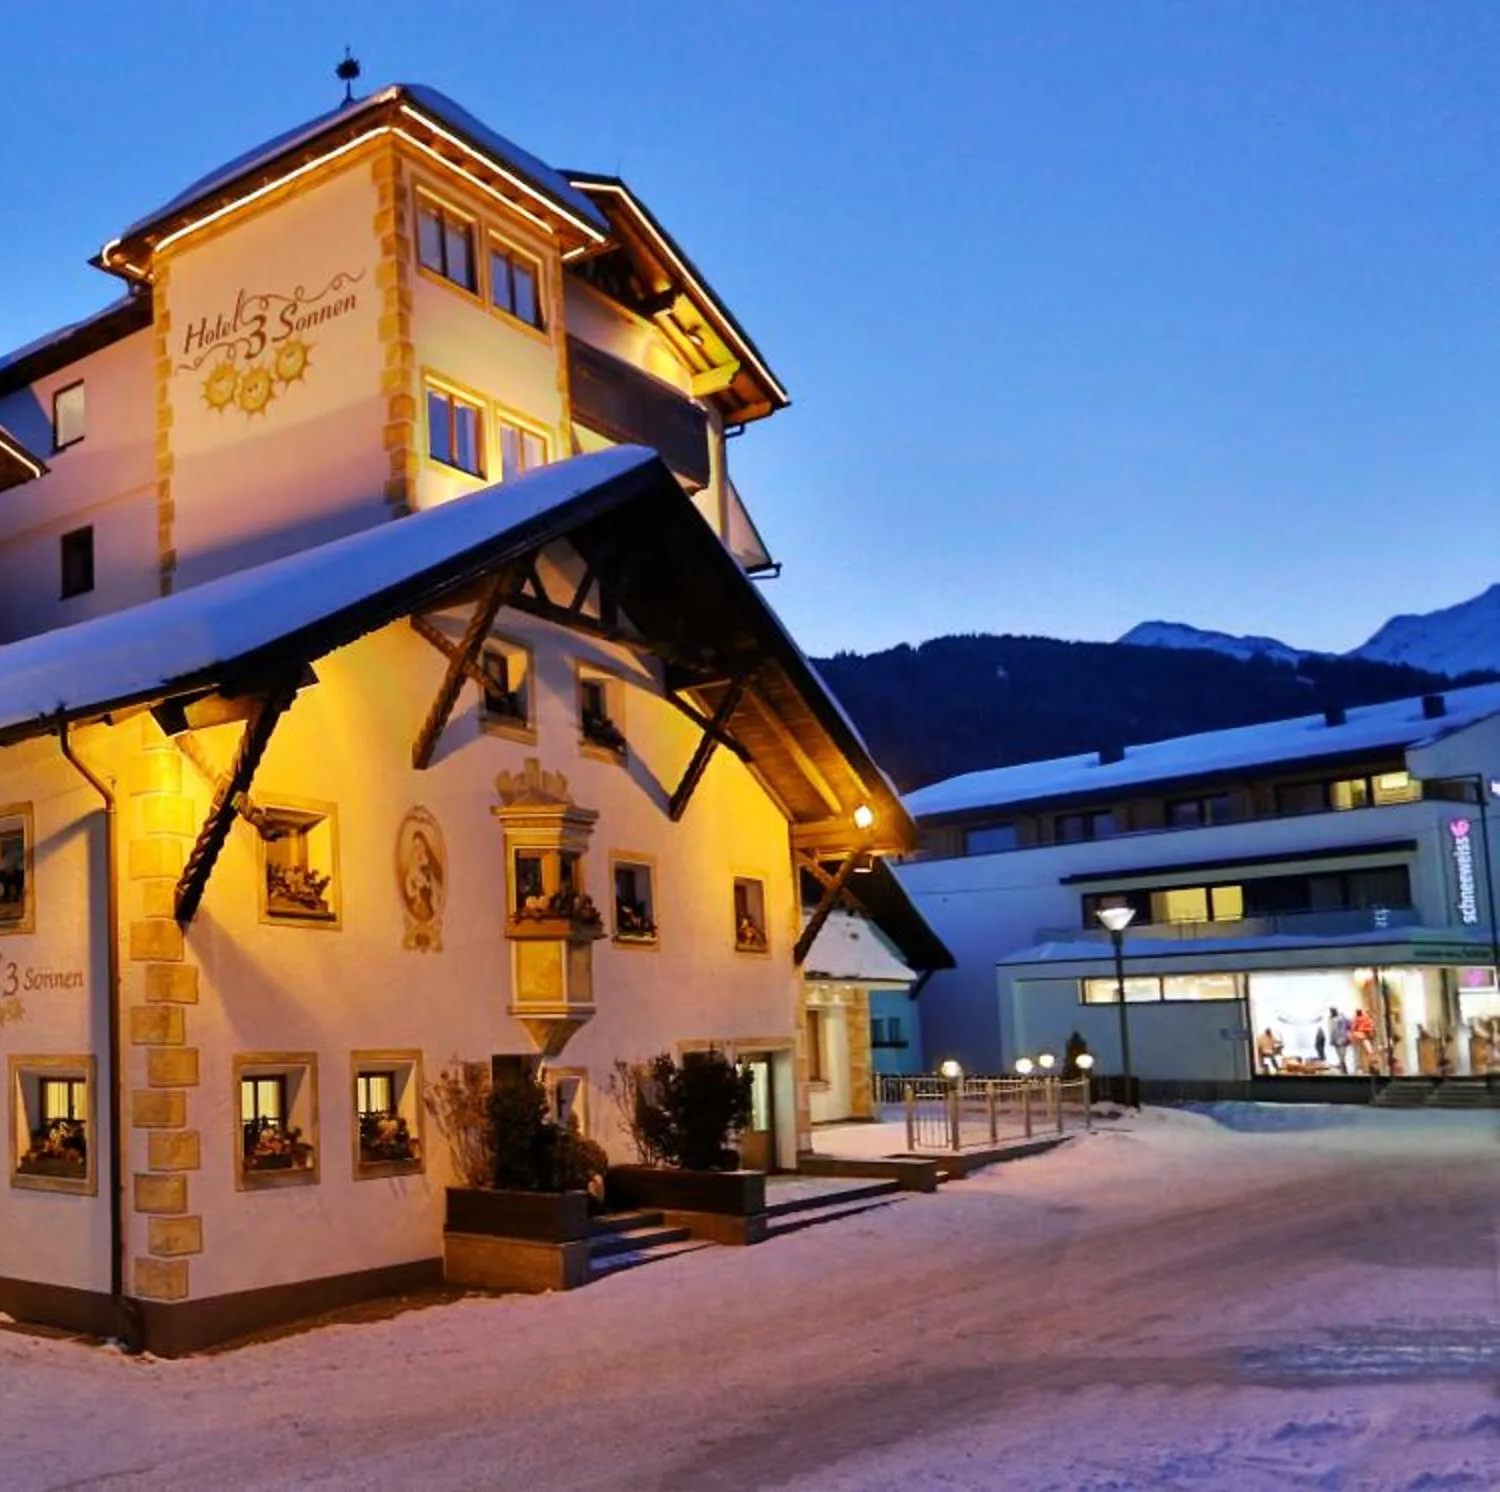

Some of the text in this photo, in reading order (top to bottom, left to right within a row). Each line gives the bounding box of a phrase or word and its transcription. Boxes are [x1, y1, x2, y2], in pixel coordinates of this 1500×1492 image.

[183, 288, 357, 360] Hotel 3 Sonnen
[1453, 834, 1478, 925] schneeweiss
[2, 962, 19, 997] 3
[23, 967, 84, 991] Sonnen
